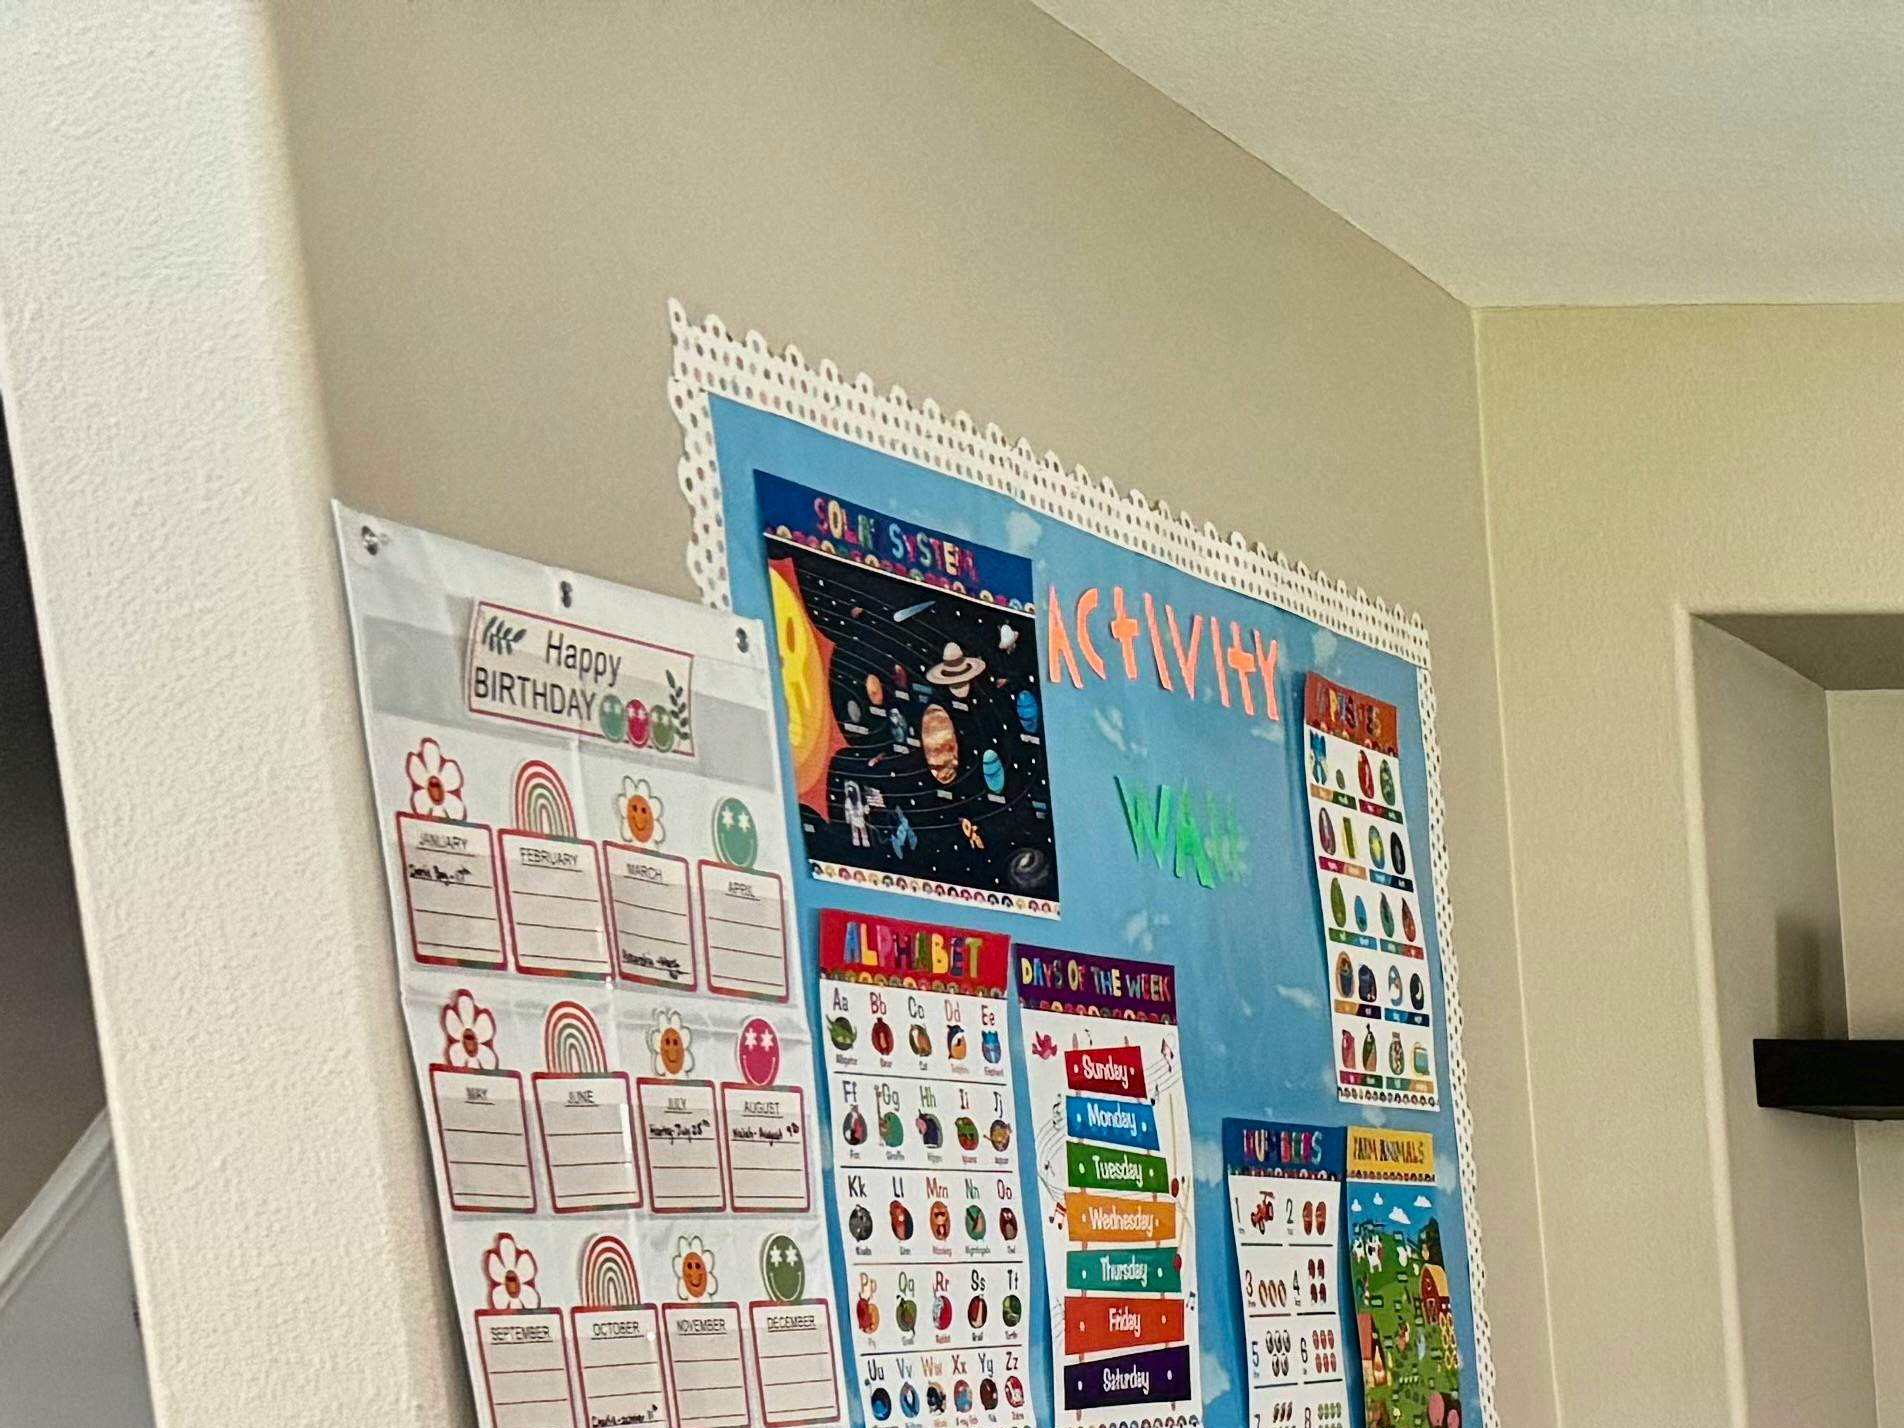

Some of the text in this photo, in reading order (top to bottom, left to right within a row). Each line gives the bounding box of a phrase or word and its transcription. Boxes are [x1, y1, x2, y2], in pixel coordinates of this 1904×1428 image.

[888, 523, 980, 584] SYSTEM
[545, 629, 621, 687] Happy
[474, 667, 601, 722] BIRTHDAY
[418, 833, 469, 850] JANUARY
[519, 847, 579, 867] FEBRUARY
[626, 863, 663, 881] MARCH
[728, 881, 755, 897] APRIL
[843, 921, 983, 979] ALPHABET
[1020, 957, 1172, 1002] DAYS OF THE WEEK
[1082, 1054, 1129, 1089] Sunday
[743, 1101, 780, 1115] AUGUST
[1087, 1103, 1137, 1137] Monday
[1379, 1138, 1425, 1165] ANIMALS
[1092, 1155, 1144, 1187] Tuesday
[1088, 1206, 1155, 1238] Wednesday
[1100, 1254, 1148, 1287] Thursday
[490, 1326, 551, 1342] SEPTEMBER
[592, 1321, 640, 1337] OCTOBER
[676, 1318, 727, 1333] NOVEMBER
[767, 1315, 816, 1330] DECEMBER
[1108, 1306, 1143, 1338] Friday
[1103, 1364, 1150, 1396] Saturday
